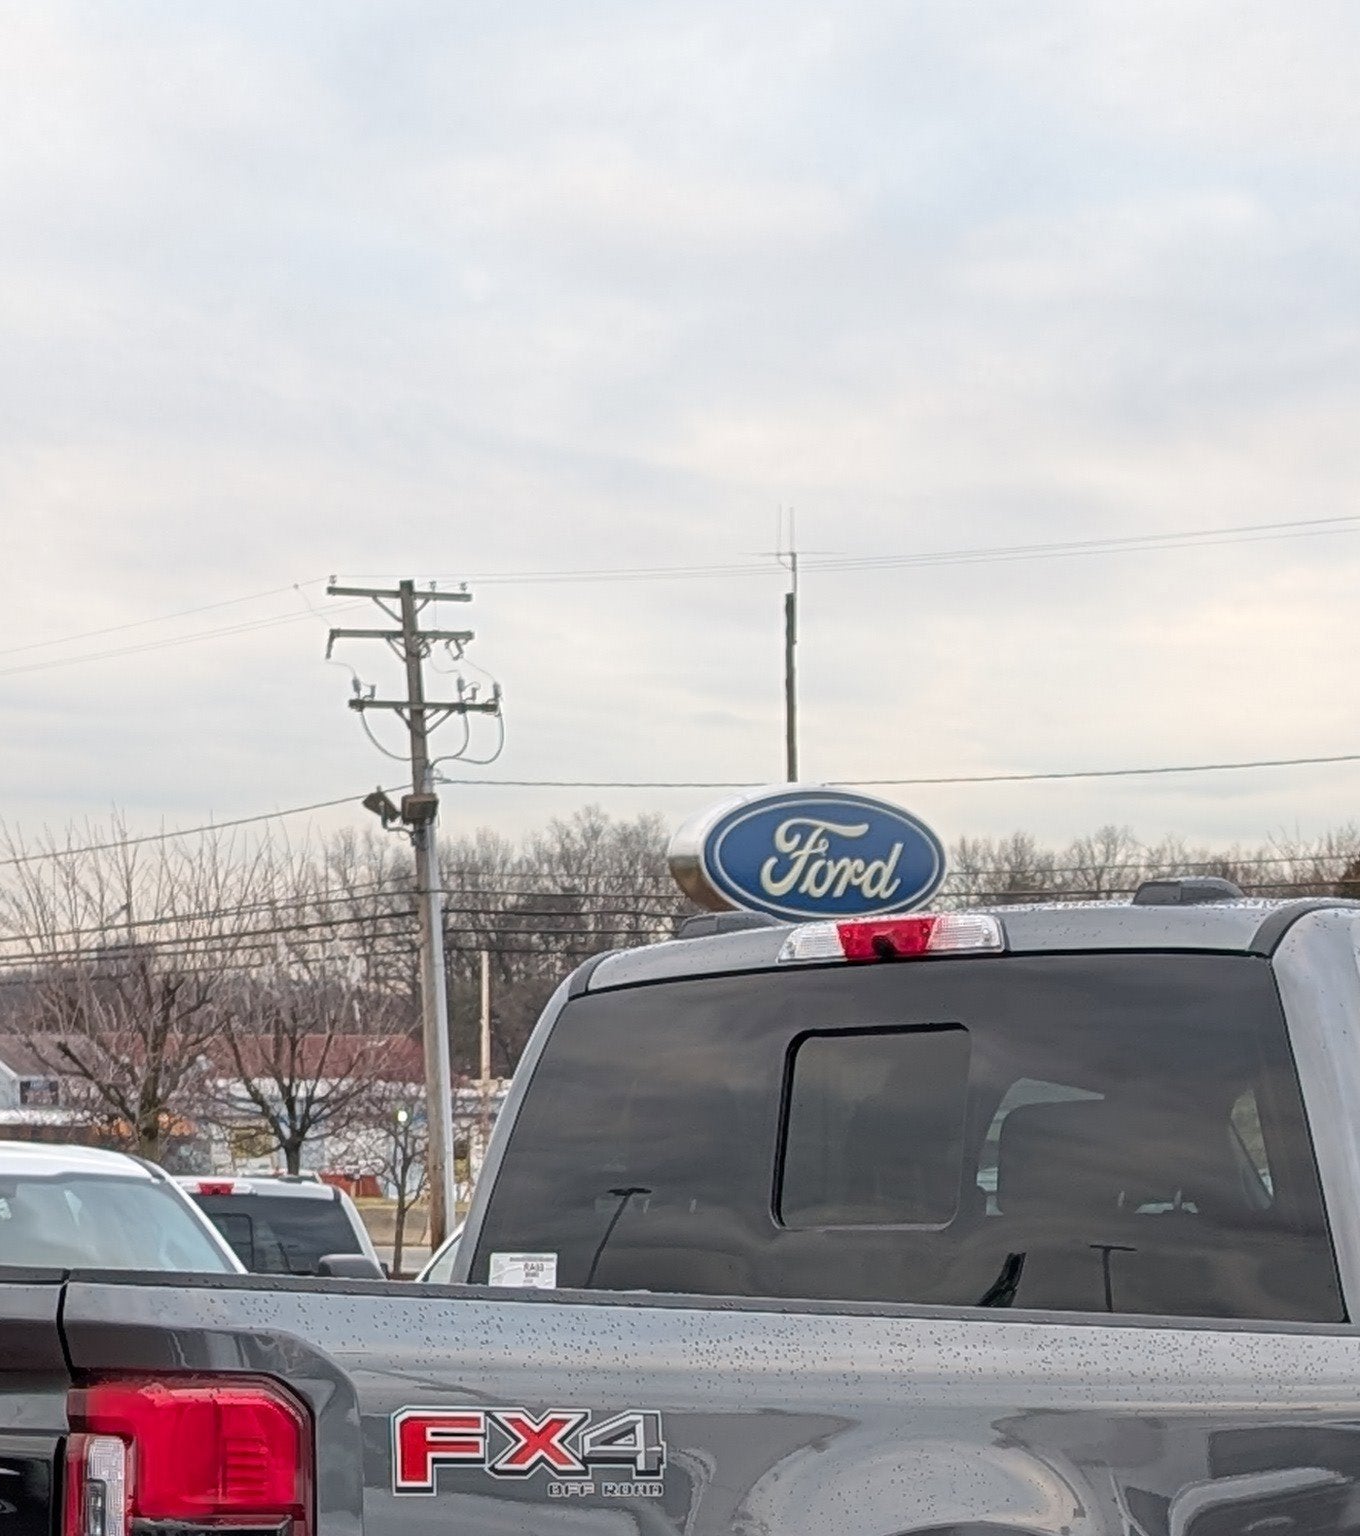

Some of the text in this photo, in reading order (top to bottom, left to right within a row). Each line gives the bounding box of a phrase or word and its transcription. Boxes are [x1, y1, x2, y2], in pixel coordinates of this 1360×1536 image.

[760, 817, 904, 900] Ford
[392, 1405, 667, 1497] FX4
[548, 1482, 595, 1497] OFF
